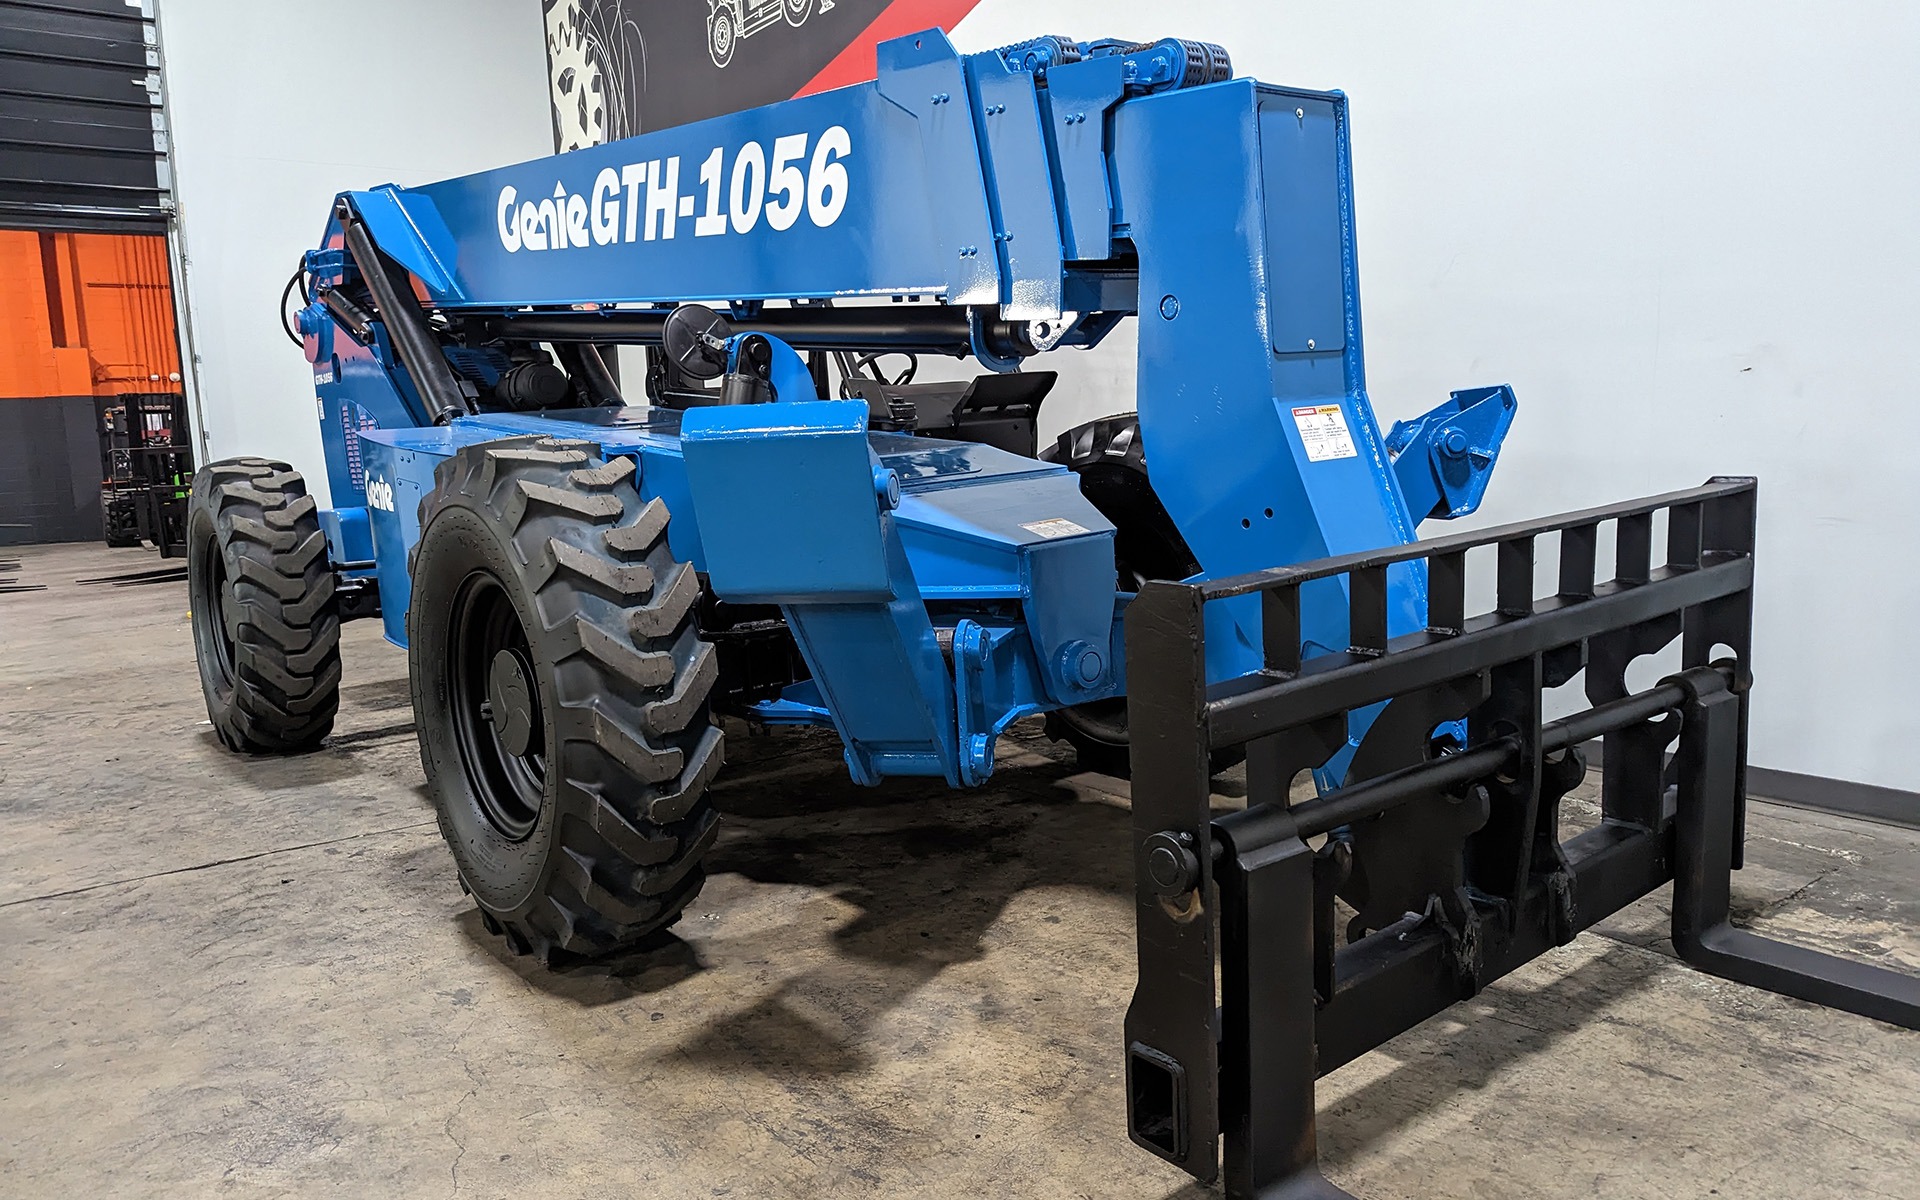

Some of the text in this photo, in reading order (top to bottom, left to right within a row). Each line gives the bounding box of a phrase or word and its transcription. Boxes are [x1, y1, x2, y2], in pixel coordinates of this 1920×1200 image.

[497, 125, 852, 253] Genie GTH-1056
[364, 469, 395, 512] Genie
